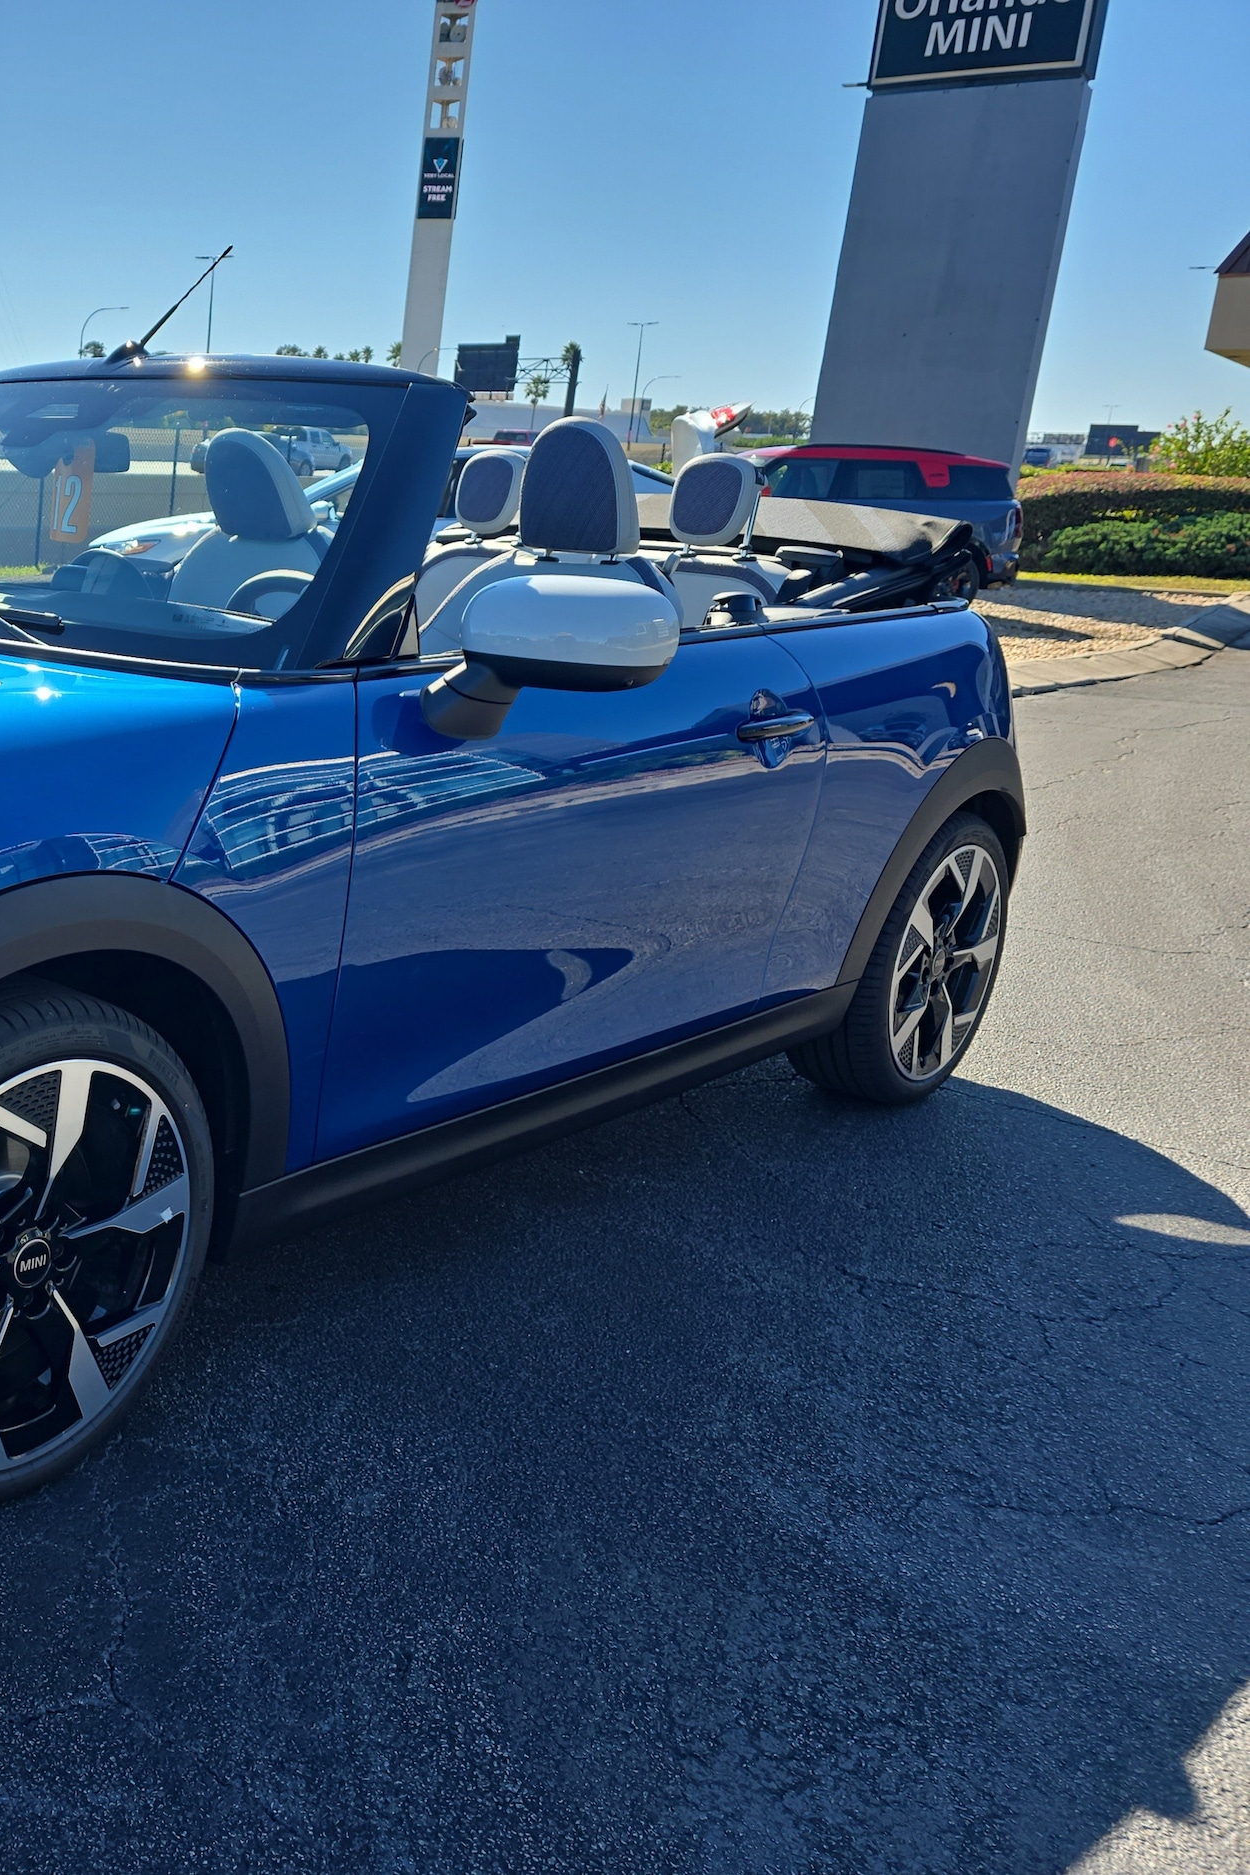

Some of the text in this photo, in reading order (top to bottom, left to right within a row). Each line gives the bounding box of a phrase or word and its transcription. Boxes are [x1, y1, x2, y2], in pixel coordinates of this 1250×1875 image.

[924, 11, 1033, 57] MINI
[423, 185, 452, 193] STREAM
[53, 474, 82, 534] 12
[19, 1253, 47, 1273] MINI
